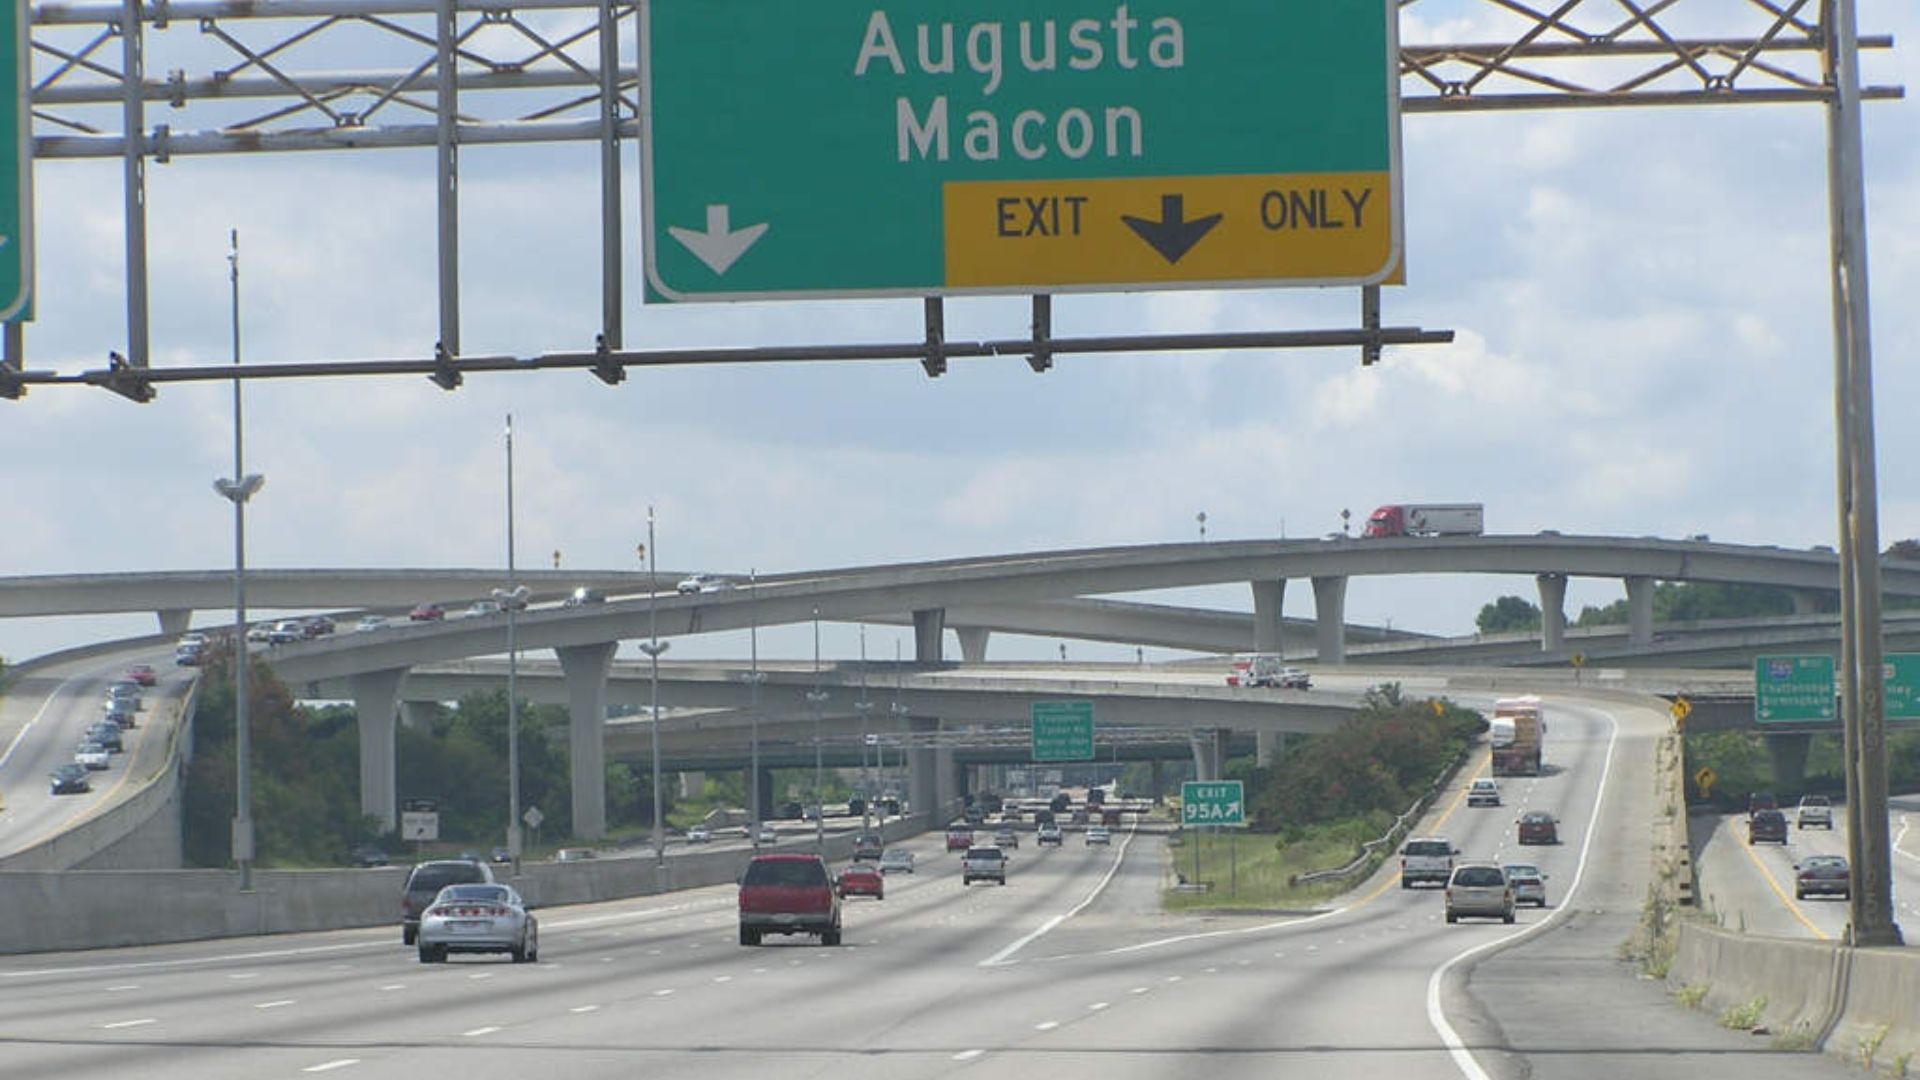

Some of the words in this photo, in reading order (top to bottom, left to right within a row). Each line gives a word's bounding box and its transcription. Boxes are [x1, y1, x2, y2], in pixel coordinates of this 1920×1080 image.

[854, 4, 1184, 96] Augusta
[896, 96, 1143, 162] Macon
[997, 196, 1089, 238] EXIT
[1260, 188, 1372, 231] ONLY
[1186, 803, 1224, 820] 95A
[1197, 787, 1227, 799] EXIT
